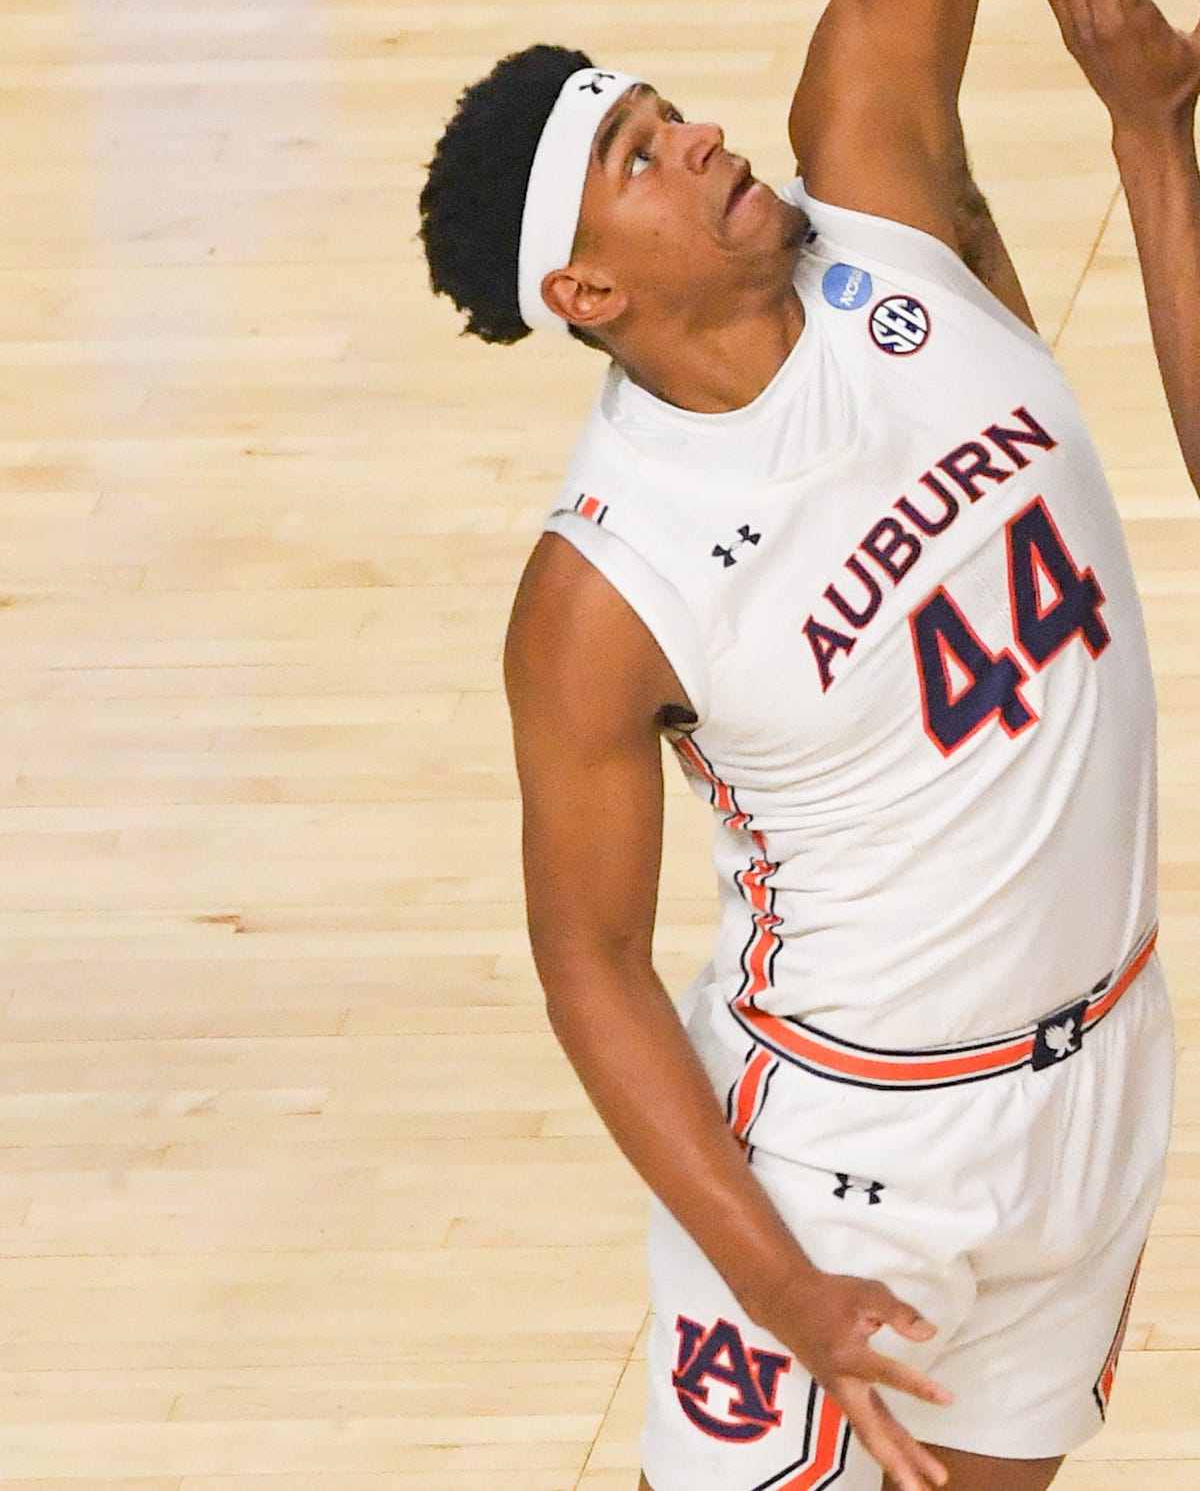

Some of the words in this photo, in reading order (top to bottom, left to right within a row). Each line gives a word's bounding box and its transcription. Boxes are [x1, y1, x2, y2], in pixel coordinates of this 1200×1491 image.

[870, 297, 929, 355] SEC
[801, 405, 1059, 693] AUBURN
[907, 494, 1112, 758] 44
